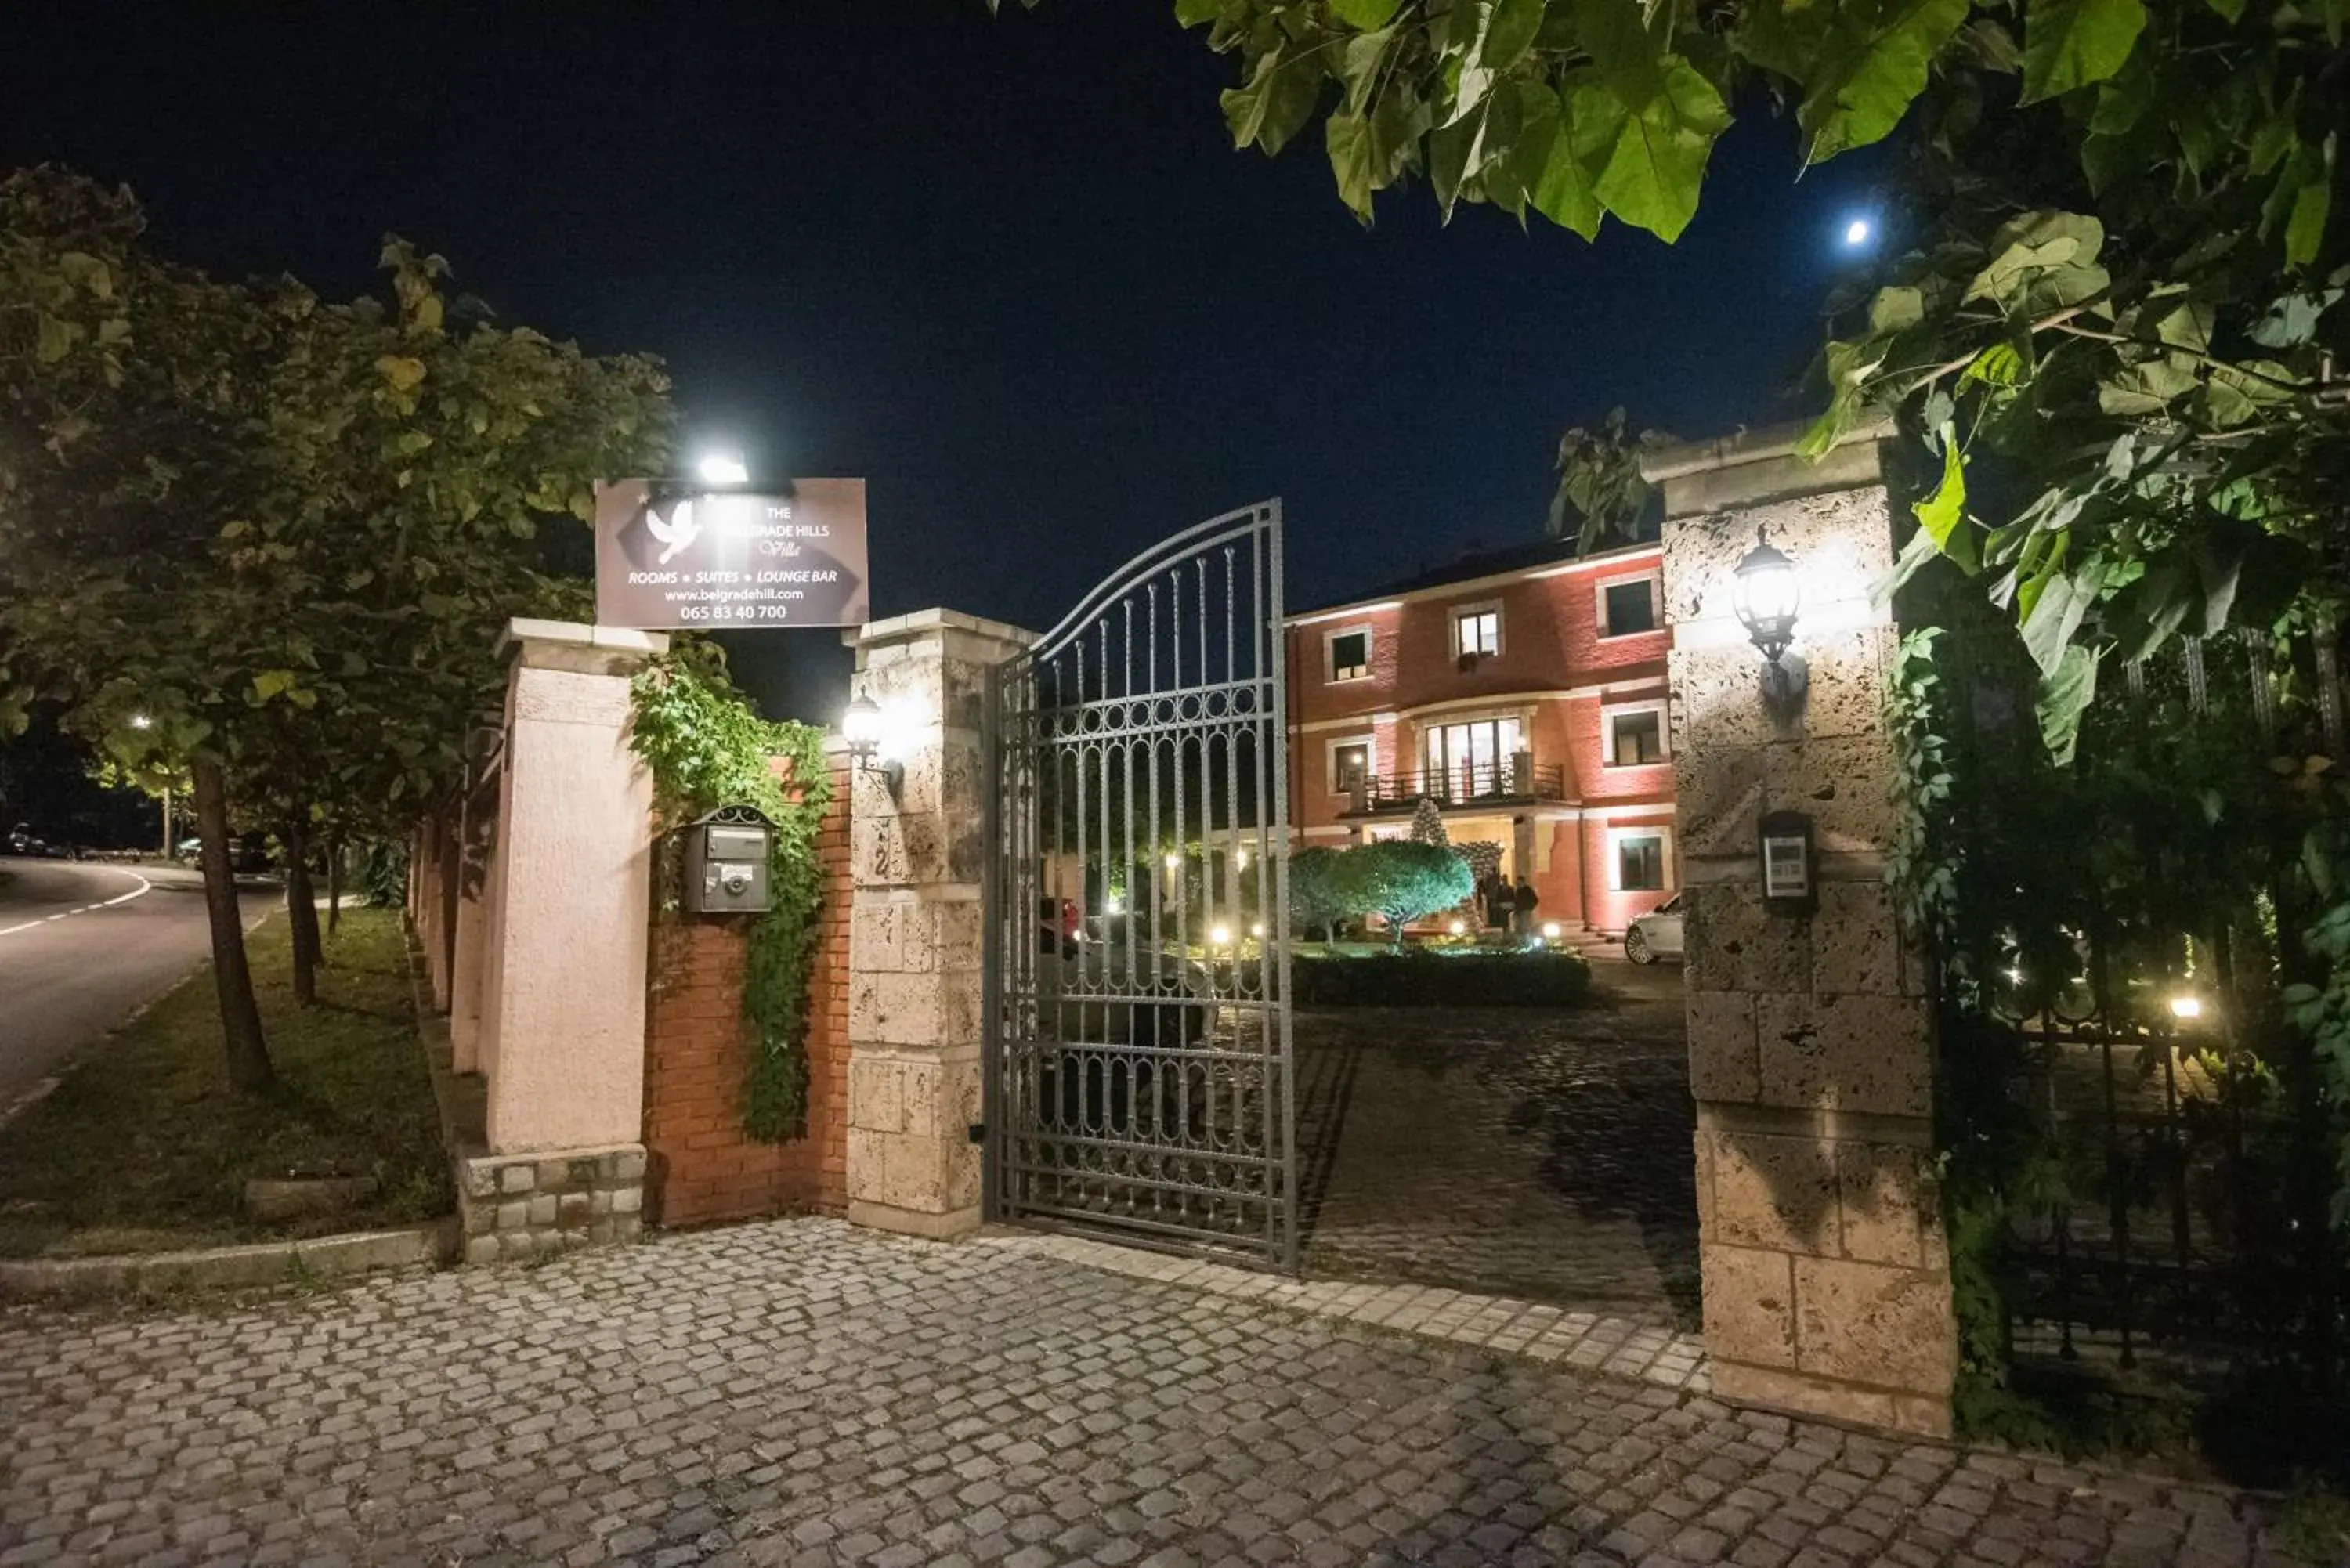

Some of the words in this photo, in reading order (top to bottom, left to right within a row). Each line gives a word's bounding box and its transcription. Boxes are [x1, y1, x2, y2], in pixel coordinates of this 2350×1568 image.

[765, 507, 791, 520] THE
[795, 525, 831, 537] HILLS
[628, 571, 678, 584] ROOMS
[695, 570, 739, 583] SUITES
[757, 570, 812, 583] LOUNGE
[812, 570, 837, 583] BAR
[665, 588, 804, 602] www.belgradehill.com
[681, 605, 709, 620] 065
[714, 605, 732, 620] 83
[736, 605, 754, 620] 40
[757, 605, 787, 619] 700
